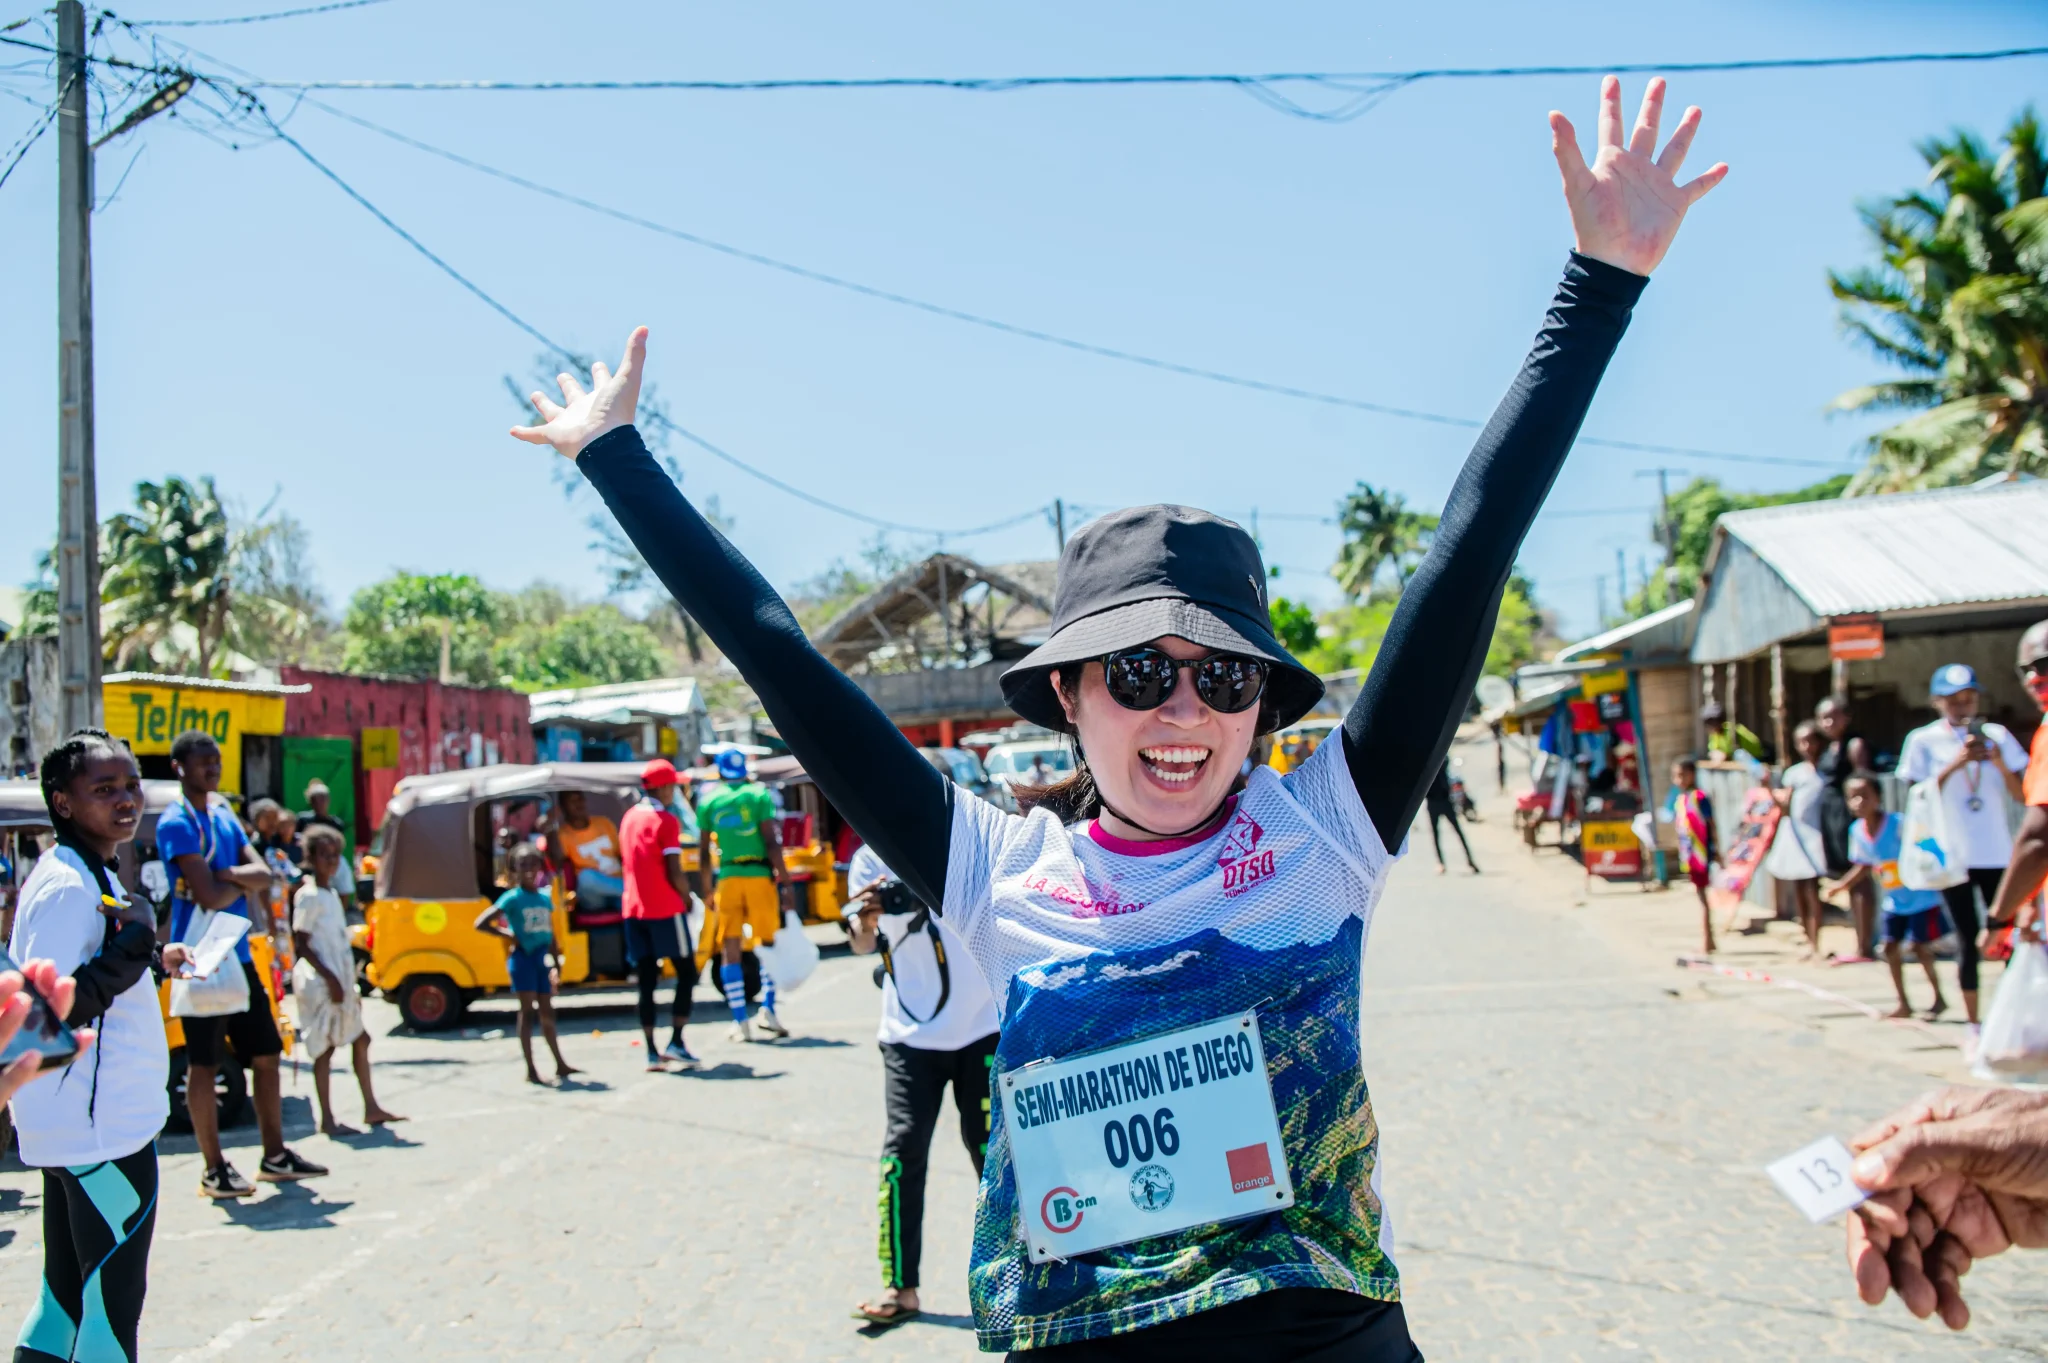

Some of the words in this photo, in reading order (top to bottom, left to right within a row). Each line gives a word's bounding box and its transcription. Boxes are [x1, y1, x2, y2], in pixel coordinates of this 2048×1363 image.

[130, 691, 230, 744] Telma
[1023, 874, 1048, 892] LA
[1014, 1054, 1164, 1130] SEMI-MARATHON
[1163, 1046, 1193, 1091] DE
[1192, 1031, 1254, 1084] DIEGO
[1103, 1107, 1180, 1168] 006
[1234, 1175, 1270, 1190] orange
[1798, 1158, 1842, 1193] 13
